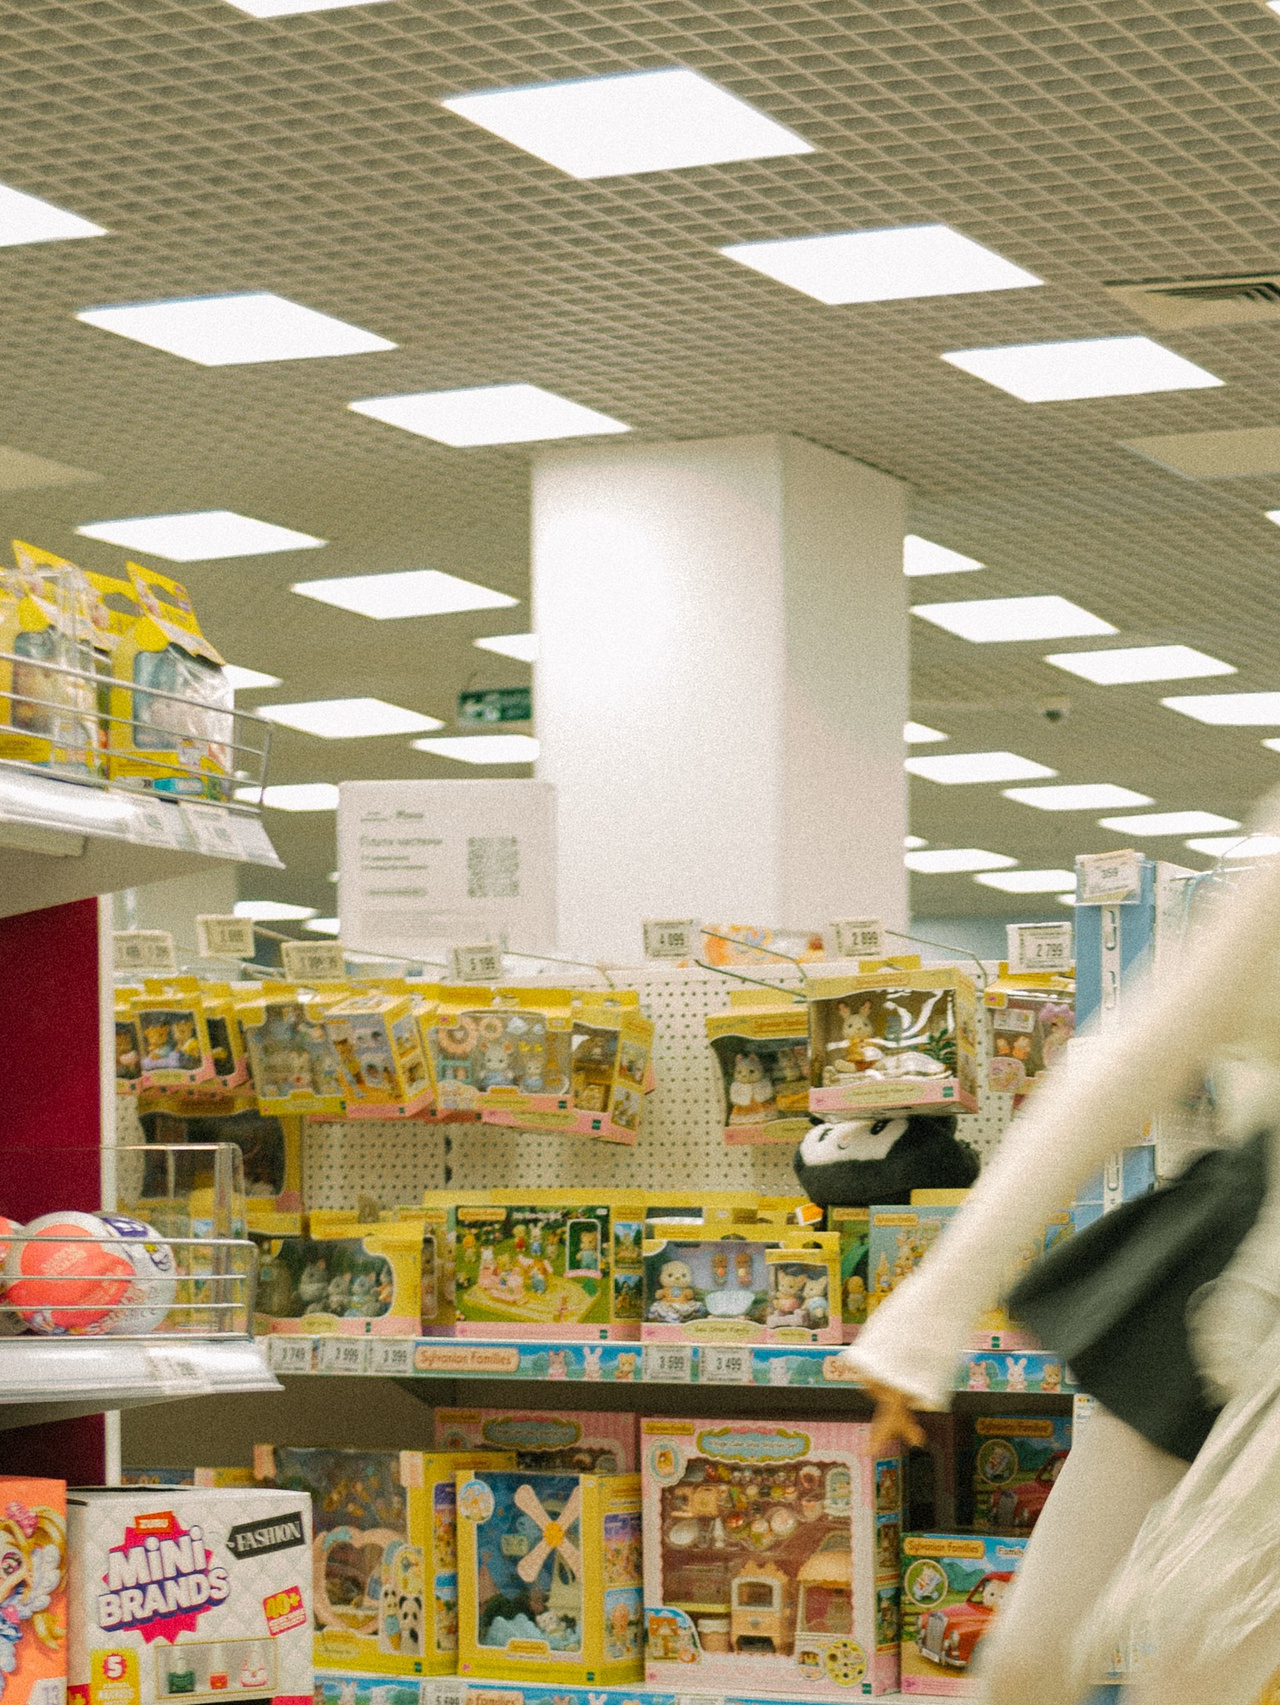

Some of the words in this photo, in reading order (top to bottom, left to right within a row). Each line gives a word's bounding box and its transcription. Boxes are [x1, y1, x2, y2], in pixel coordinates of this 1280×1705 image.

[420, 1349, 468, 1367] Sylvanian
[470, 1350, 513, 1366] Families
[235, 1520, 301, 1553] FASHION
[98, 1567, 230, 1630] BRANDS
[265, 1592, 301, 1619] 40+
